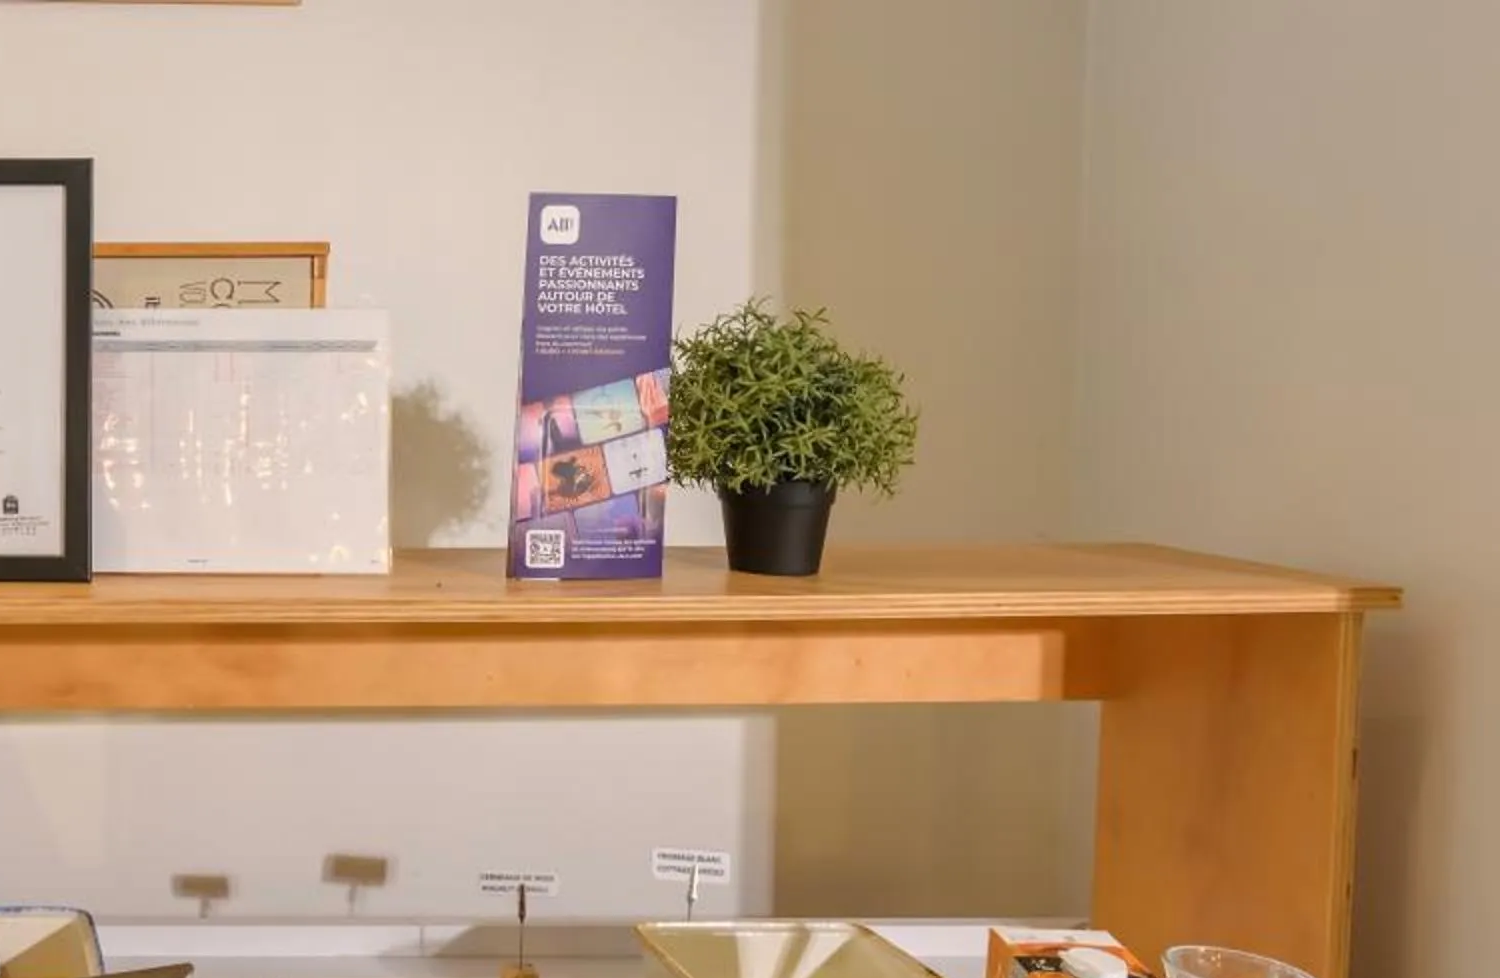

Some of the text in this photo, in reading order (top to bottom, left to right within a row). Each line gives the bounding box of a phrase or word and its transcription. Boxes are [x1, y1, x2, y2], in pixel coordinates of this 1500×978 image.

[539, 253, 635, 267] DES ACTIVITÉS
[539, 267, 556, 278] ET
[538, 279, 640, 291] PASSIONNANTS
[538, 291, 617, 302] AUTOUR DE
[537, 300, 628, 315] VOTRE HÔTEL
